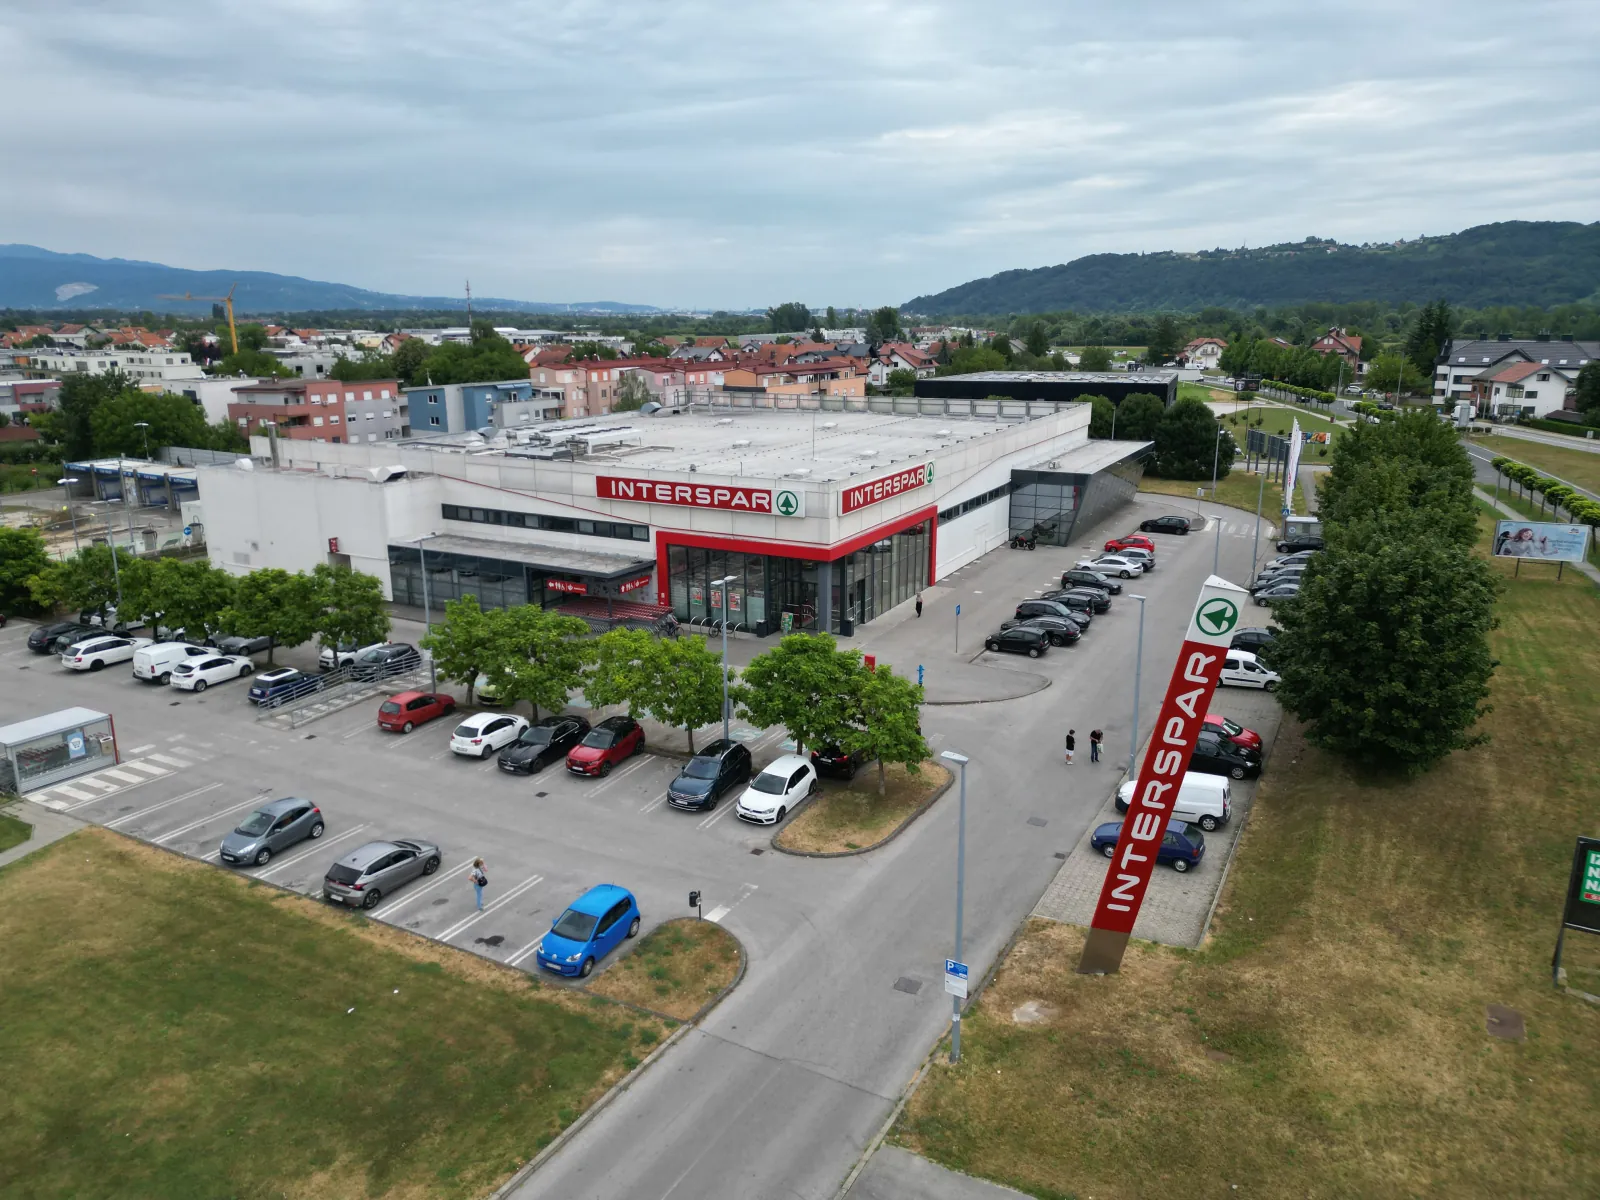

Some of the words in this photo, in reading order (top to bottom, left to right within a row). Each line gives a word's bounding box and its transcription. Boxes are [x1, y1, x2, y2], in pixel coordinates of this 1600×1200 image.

[611, 480, 770, 510] INTERSPAR
[850, 468, 924, 508] INTERSPAR
[1107, 651, 1217, 912] INTERSPAR
[947, 962, 954, 971] P
